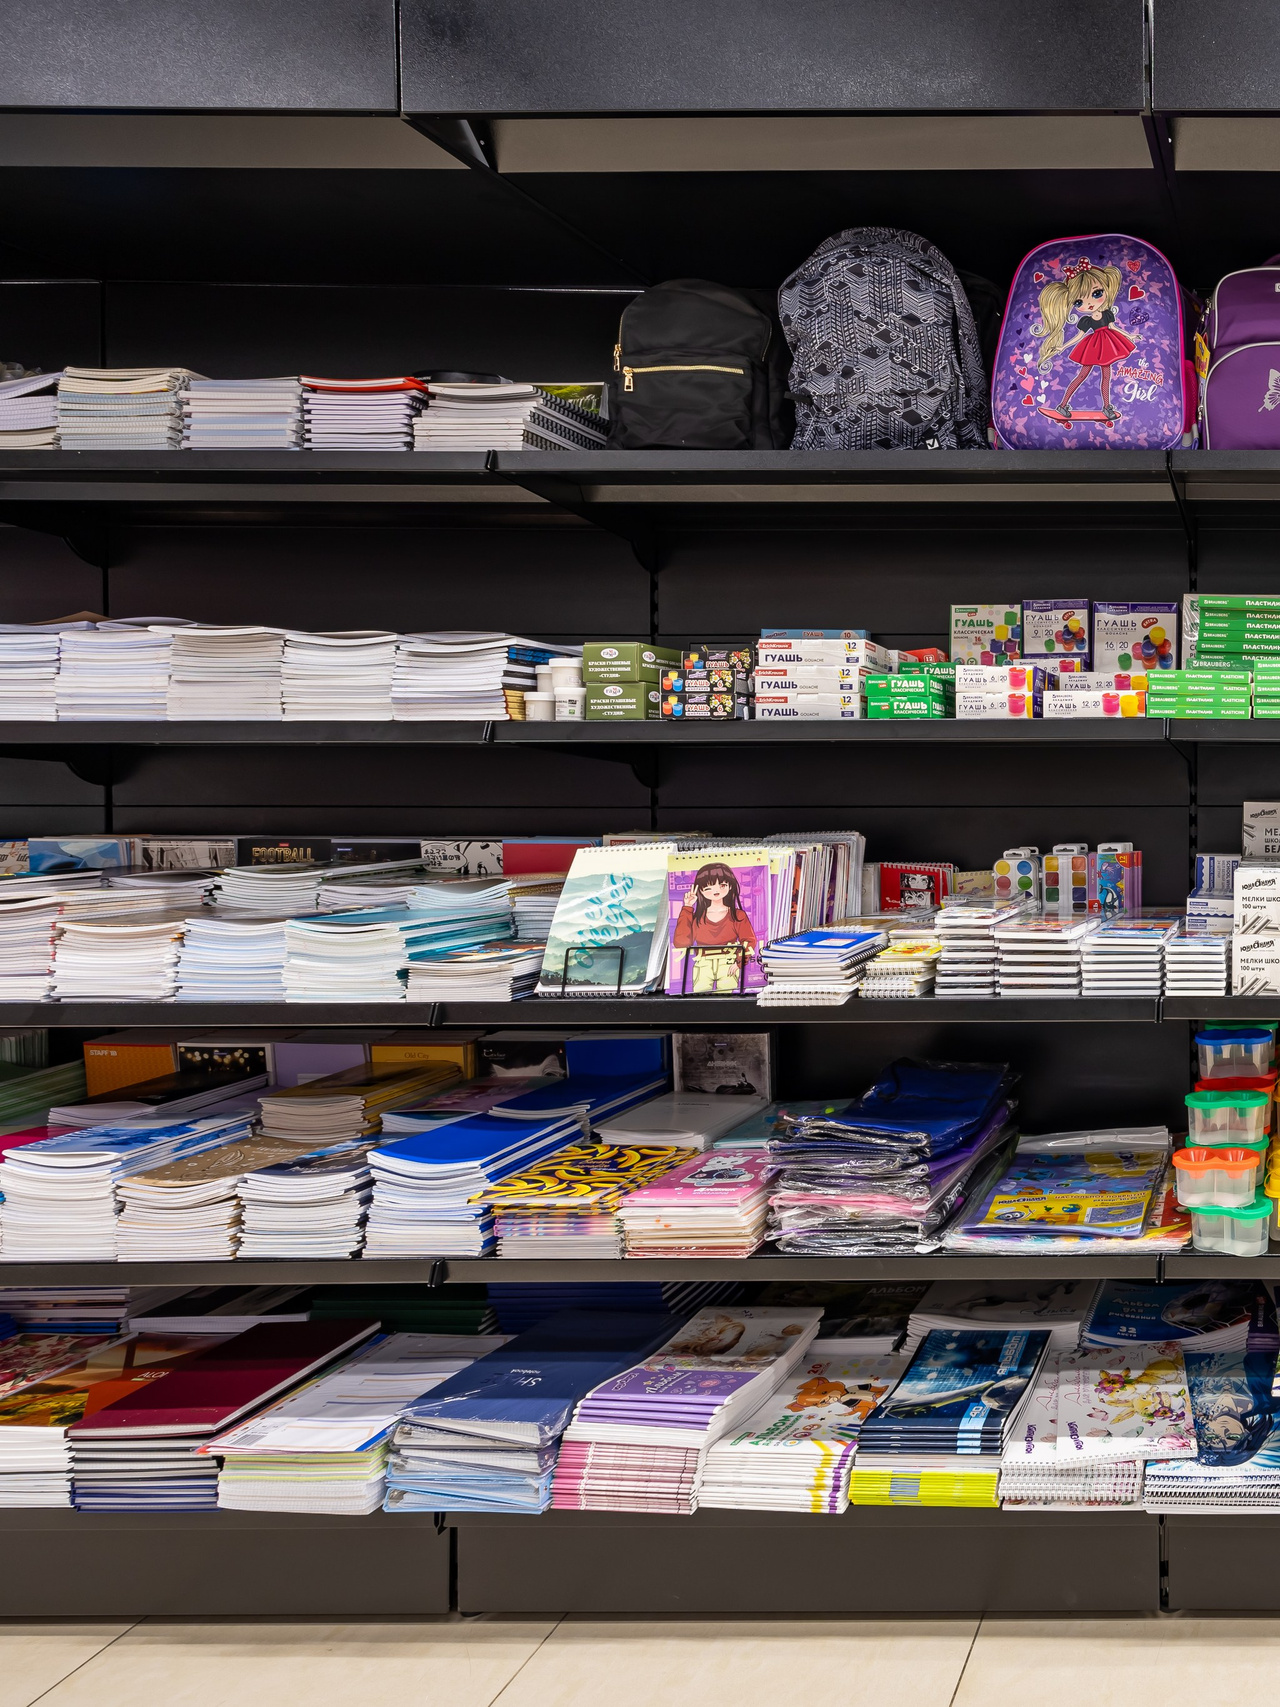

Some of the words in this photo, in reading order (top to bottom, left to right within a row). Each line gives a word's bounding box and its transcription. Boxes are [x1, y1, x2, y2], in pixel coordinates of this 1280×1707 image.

[1116, 366, 1164, 388] AMAZING
[954, 619, 994, 628] ГУАШЬ
[848, 642, 857, 650] 12
[764, 654, 803, 662] ГУАШЬ
[1200, 660, 1230, 668] BRAUBERG
[841, 668, 850, 676] 12
[760, 681, 798, 690] ГУАШЬ
[890, 680, 925, 688] ГУАШЬ
[893, 702, 928, 710] ГУАШЬ
[761, 708, 799, 716] ГУАШЬ
[252, 847, 314, 863] FOOTBALL
[1120, 1326, 1137, 1334] 32
